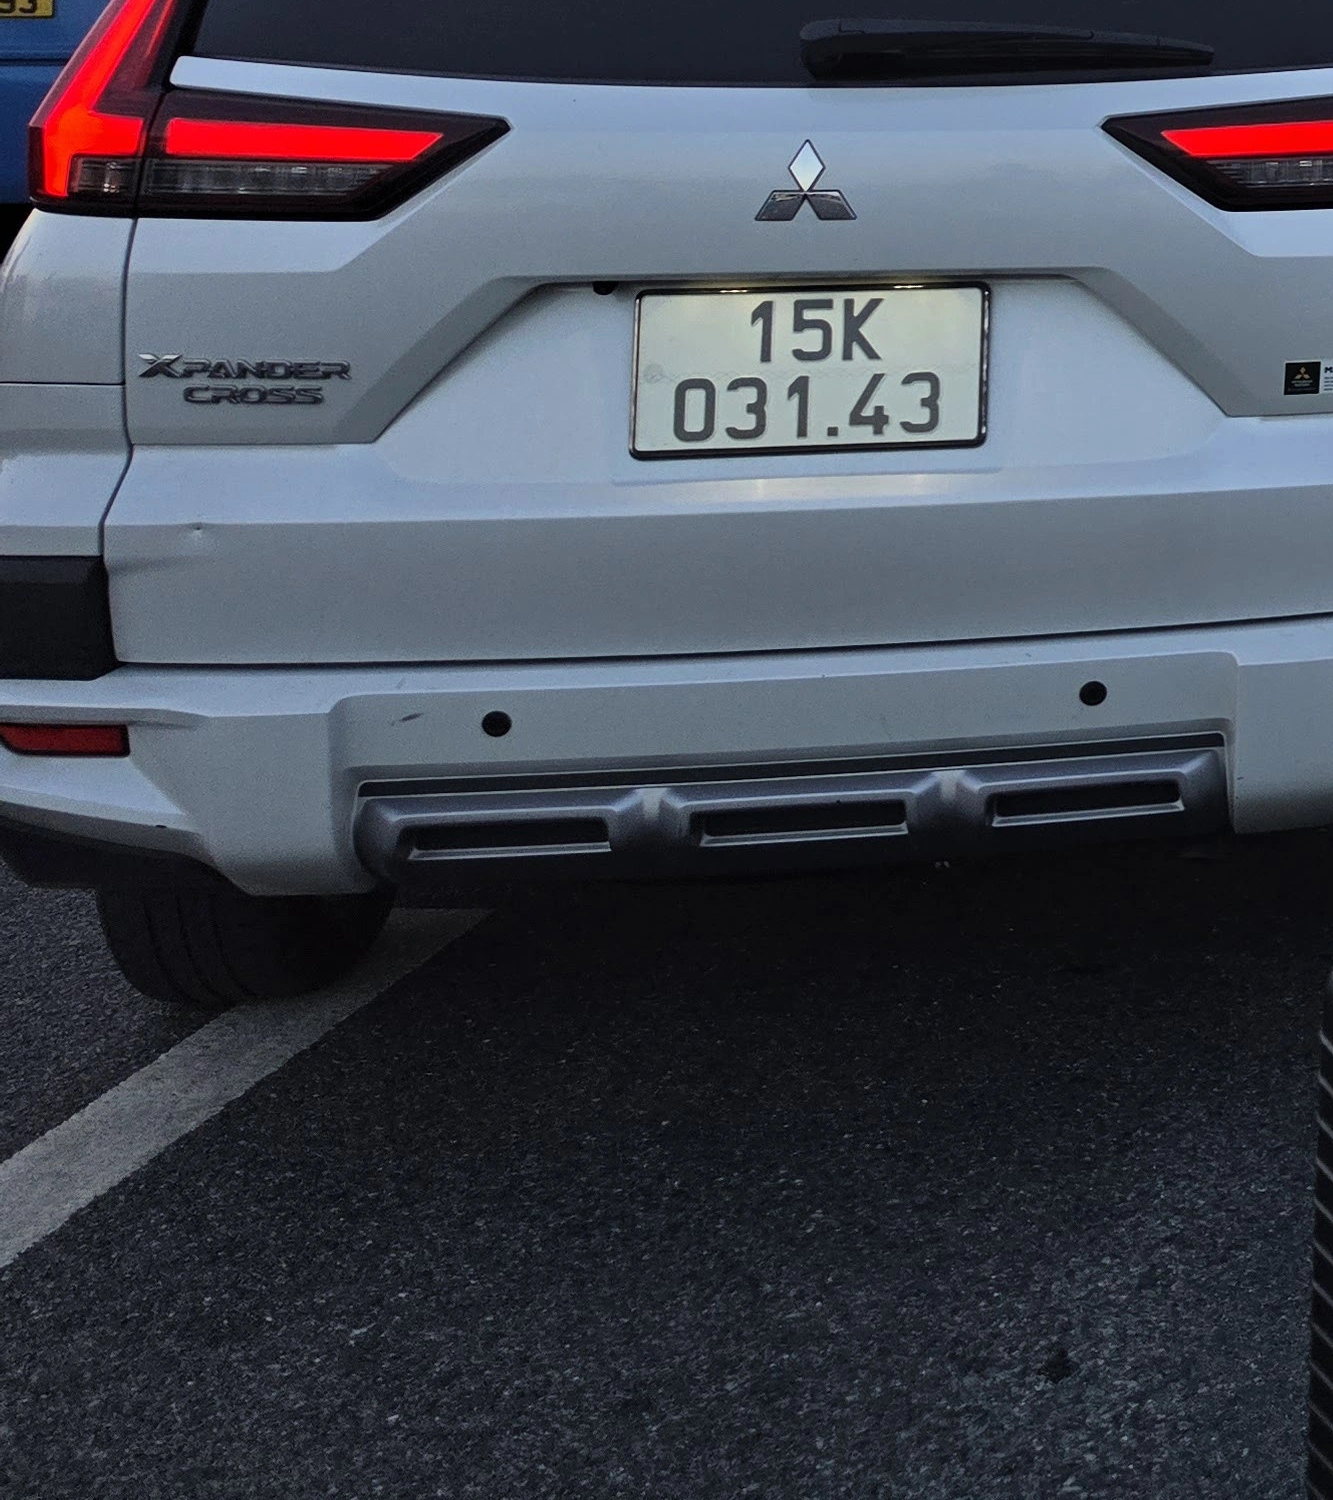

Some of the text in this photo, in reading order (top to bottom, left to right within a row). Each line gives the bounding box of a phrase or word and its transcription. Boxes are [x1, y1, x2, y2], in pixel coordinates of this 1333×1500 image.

[751, 298, 884, 363] 15K
[138, 353, 352, 380] XPANDER
[183, 384, 324, 405] CROSS
[673, 372, 941, 443] 031.43
